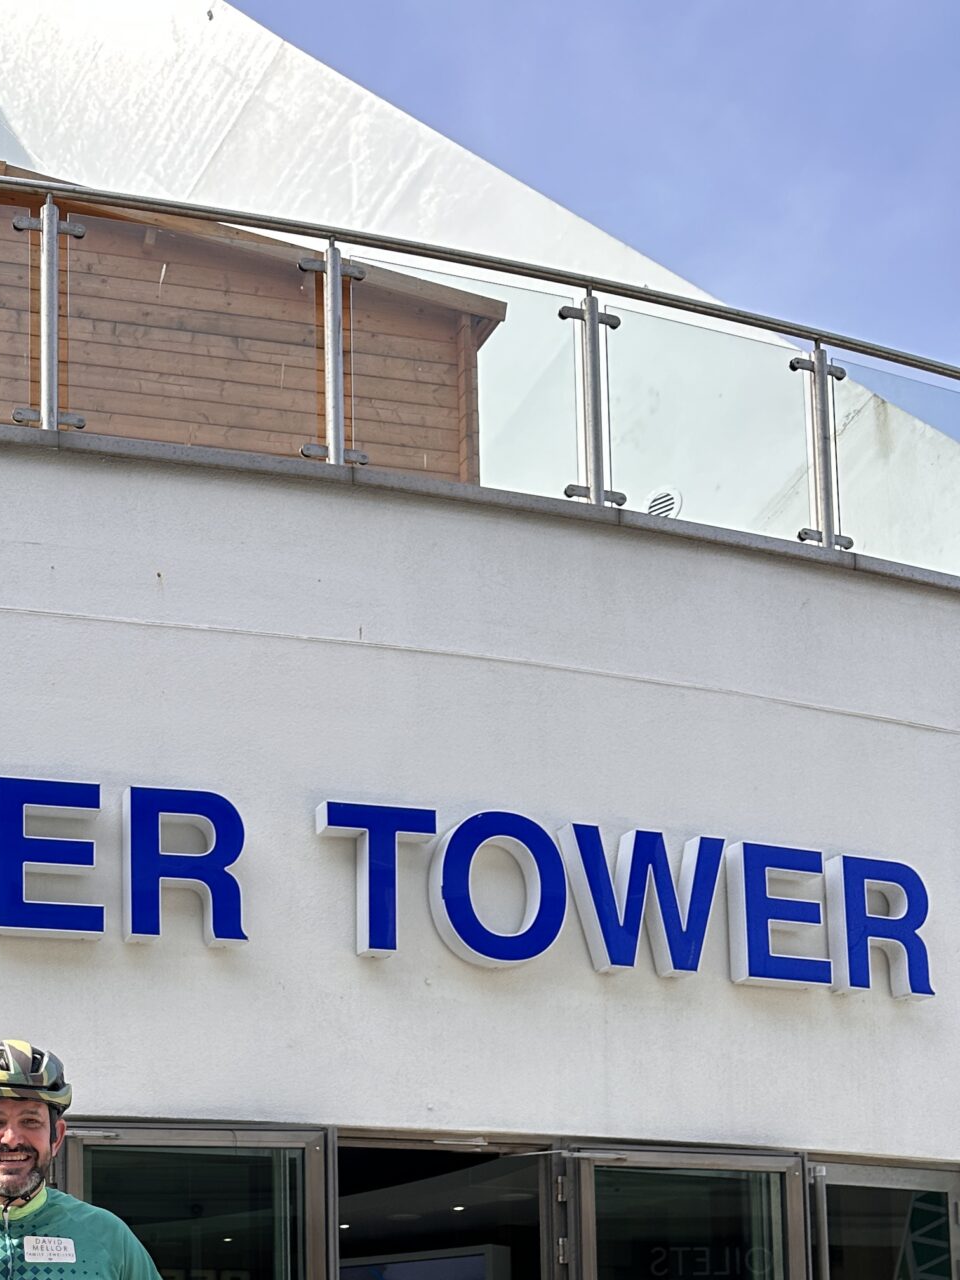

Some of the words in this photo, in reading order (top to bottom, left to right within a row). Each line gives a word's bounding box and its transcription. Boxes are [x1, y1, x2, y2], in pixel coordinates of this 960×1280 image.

[324, 800, 934, 997] TOWER
[35, 1238, 63, 1246] DAVID
[32, 1244, 68, 1252] MELLOR
